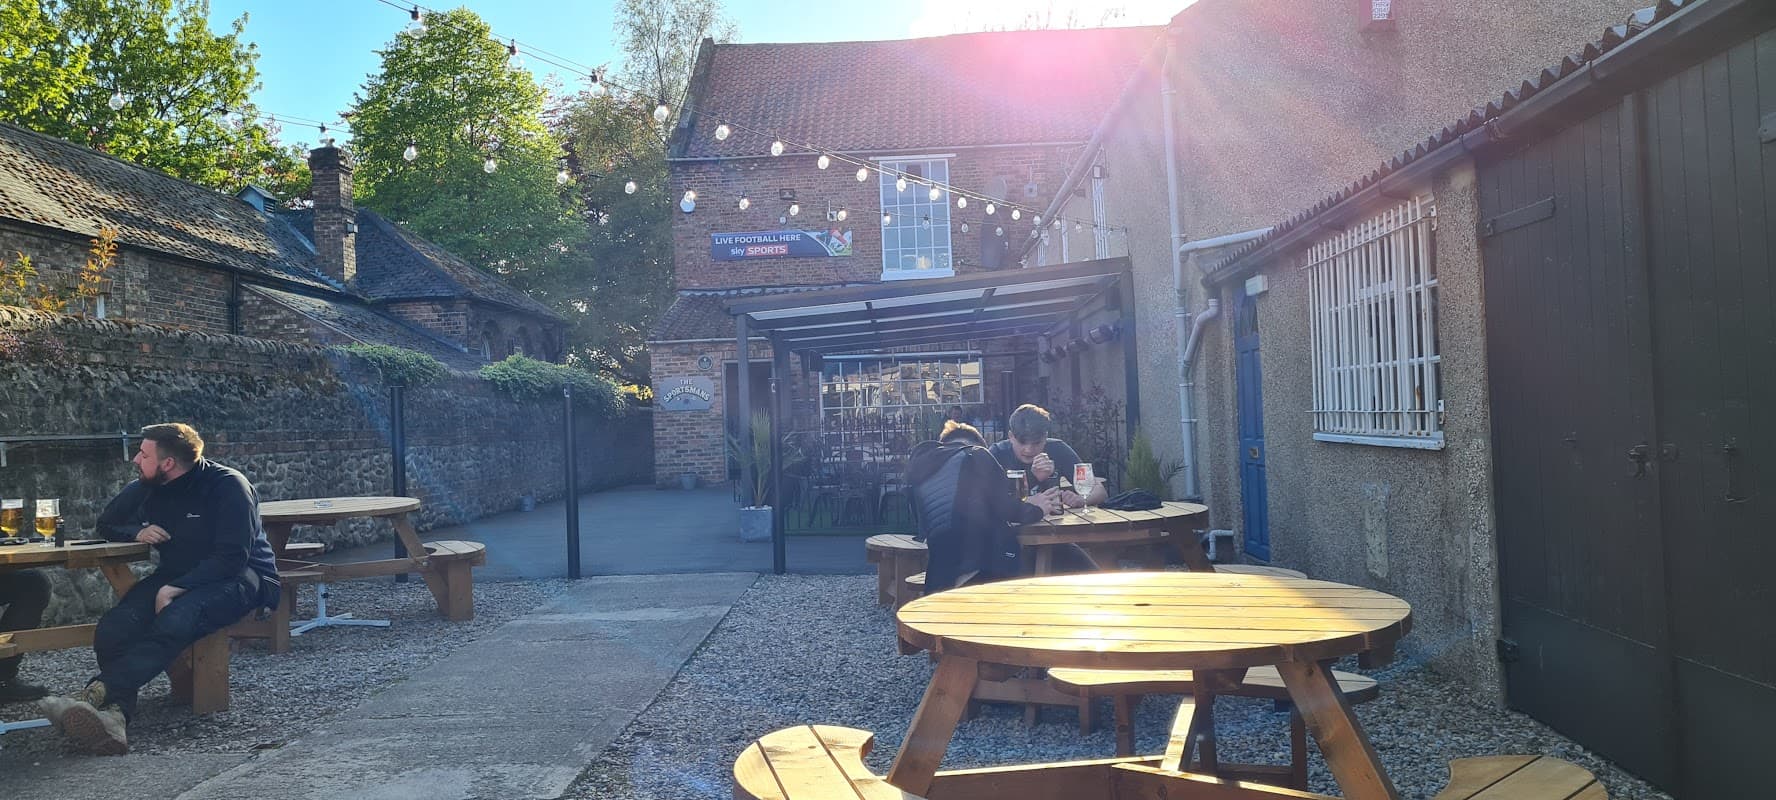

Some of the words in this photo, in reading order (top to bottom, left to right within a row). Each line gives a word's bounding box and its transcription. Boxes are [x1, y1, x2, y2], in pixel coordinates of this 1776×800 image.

[715, 236, 734, 245] LIVE
[734, 234, 778, 244] FOOTBALL
[779, 233, 801, 241] HERE
[730, 247, 745, 256] sky
[748, 245, 786, 255] SPORTS
